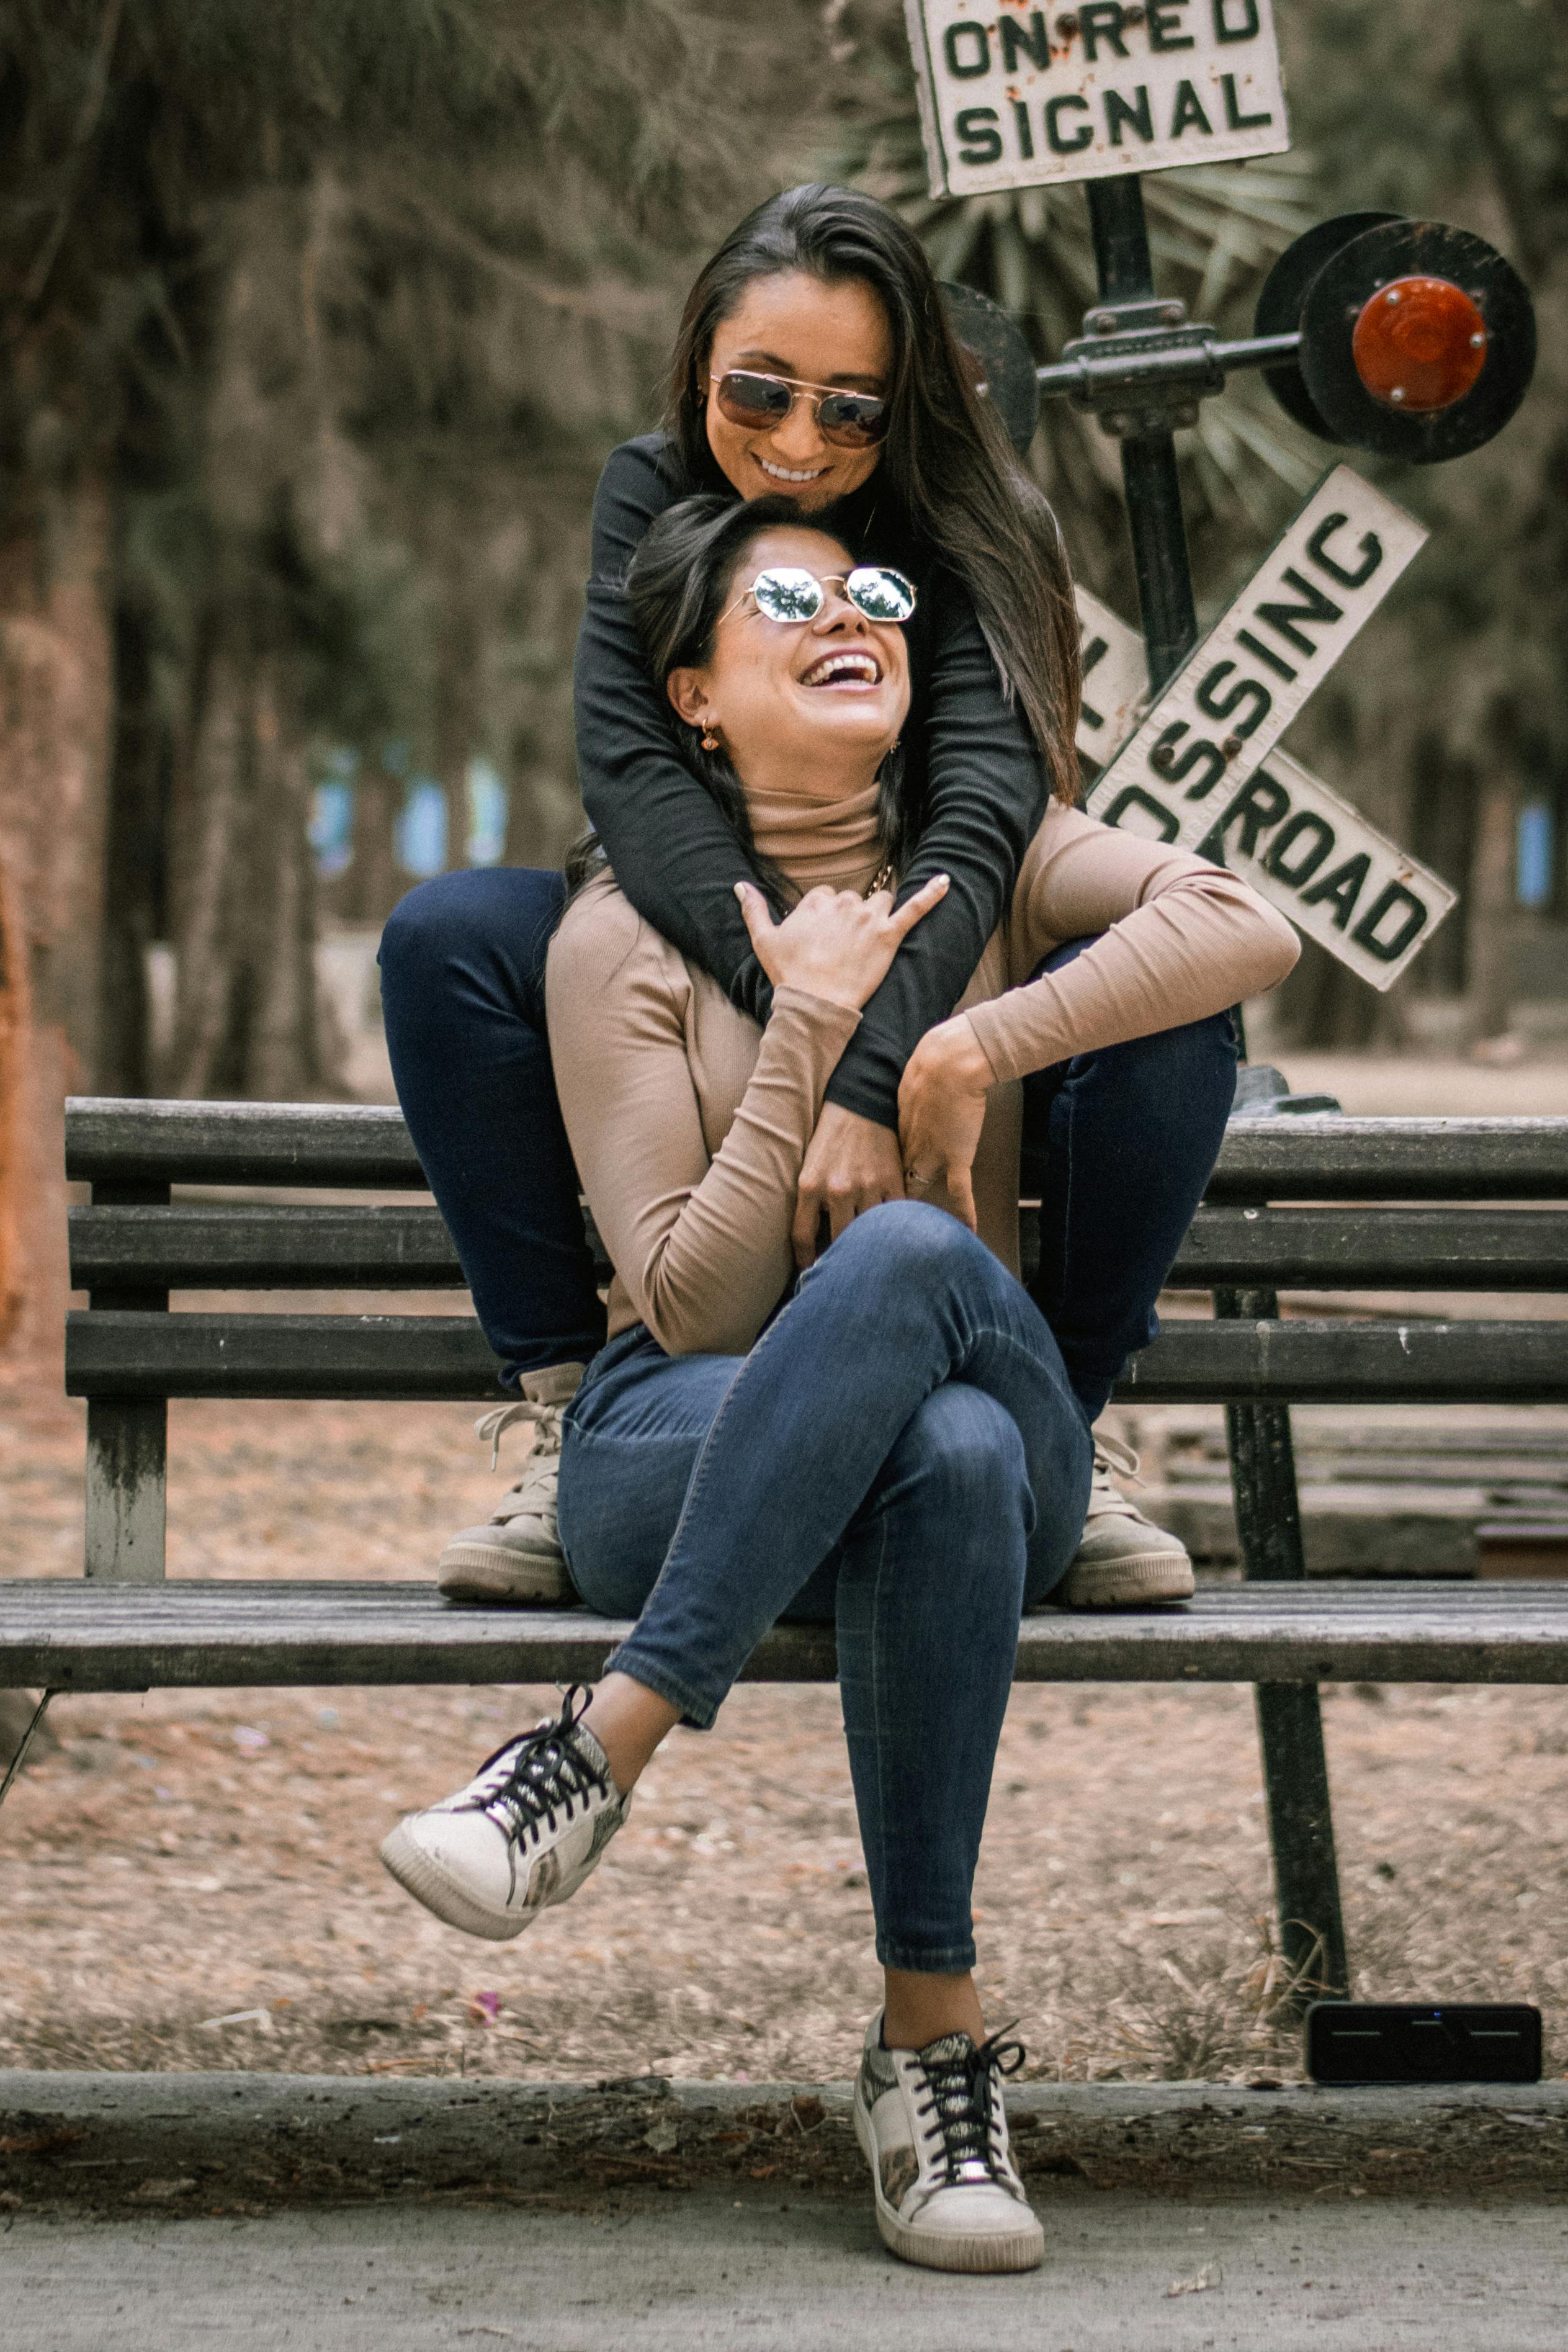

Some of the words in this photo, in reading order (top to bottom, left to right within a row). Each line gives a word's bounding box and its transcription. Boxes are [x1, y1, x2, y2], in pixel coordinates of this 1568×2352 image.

[944, 10, 1052, 80] ON
[1079, 0, 1260, 62] RED
[954, 73, 1273, 166] SIGNAL
[1101, 512, 1384, 843] OSSING
[1221, 768, 1428, 963] ROAD
